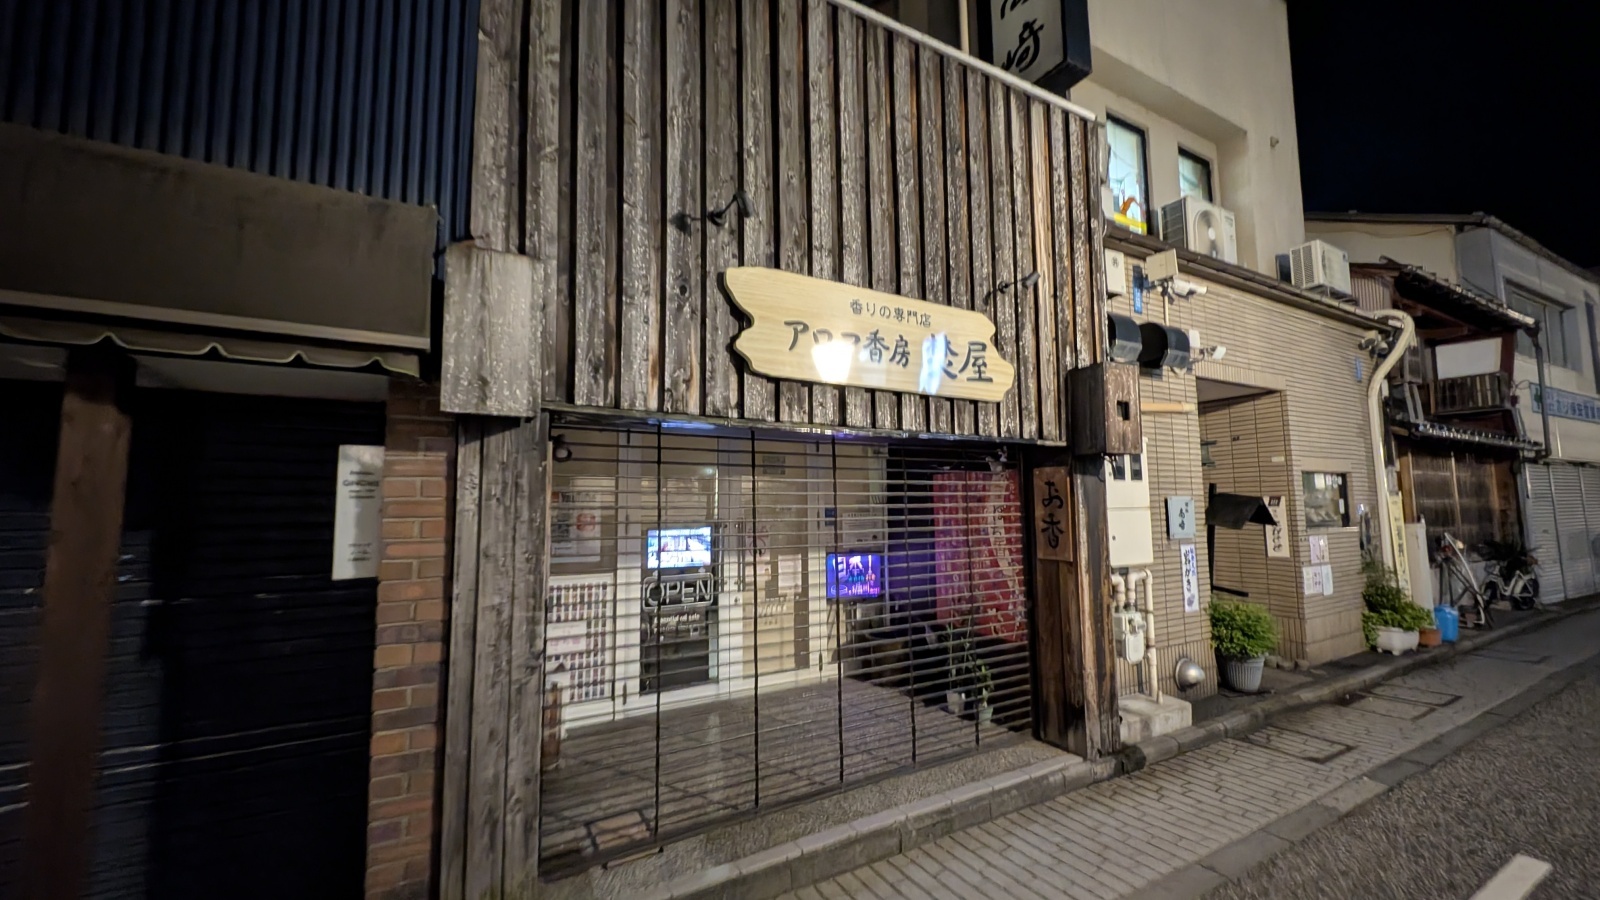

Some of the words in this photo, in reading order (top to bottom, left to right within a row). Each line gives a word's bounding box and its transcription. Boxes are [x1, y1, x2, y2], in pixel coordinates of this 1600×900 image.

[850, 298, 931, 328] 香りの専門店
[1041, 480, 1064, 549] お香
[646, 580, 711, 606] OPEN
